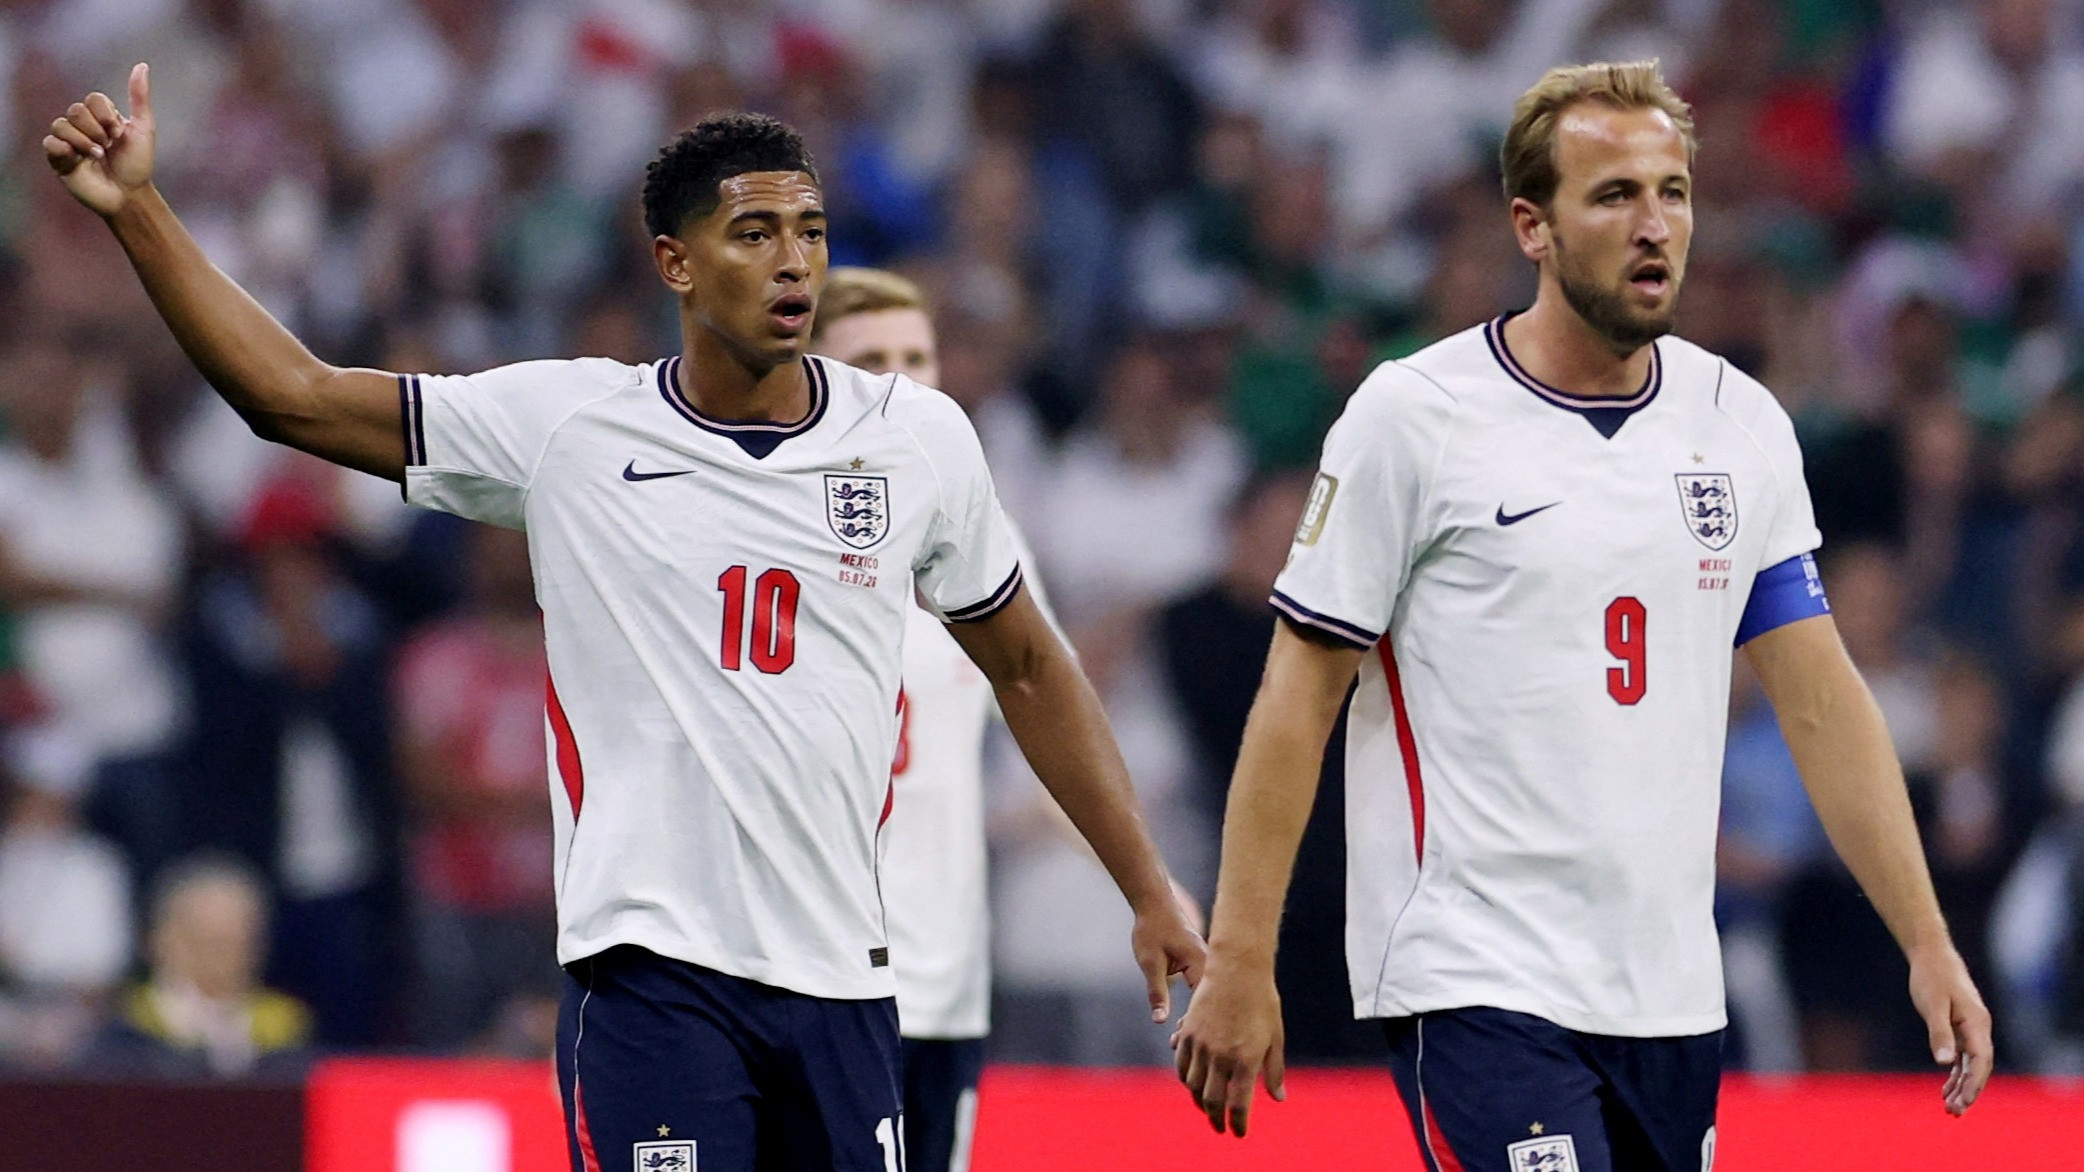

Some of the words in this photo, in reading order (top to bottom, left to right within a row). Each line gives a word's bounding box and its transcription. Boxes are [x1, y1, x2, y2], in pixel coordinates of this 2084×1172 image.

[839, 553, 879, 570] MEXICO
[718, 565, 801, 675] 10
[1604, 596, 1646, 706] 9
[875, 1114, 906, 1172] 1
